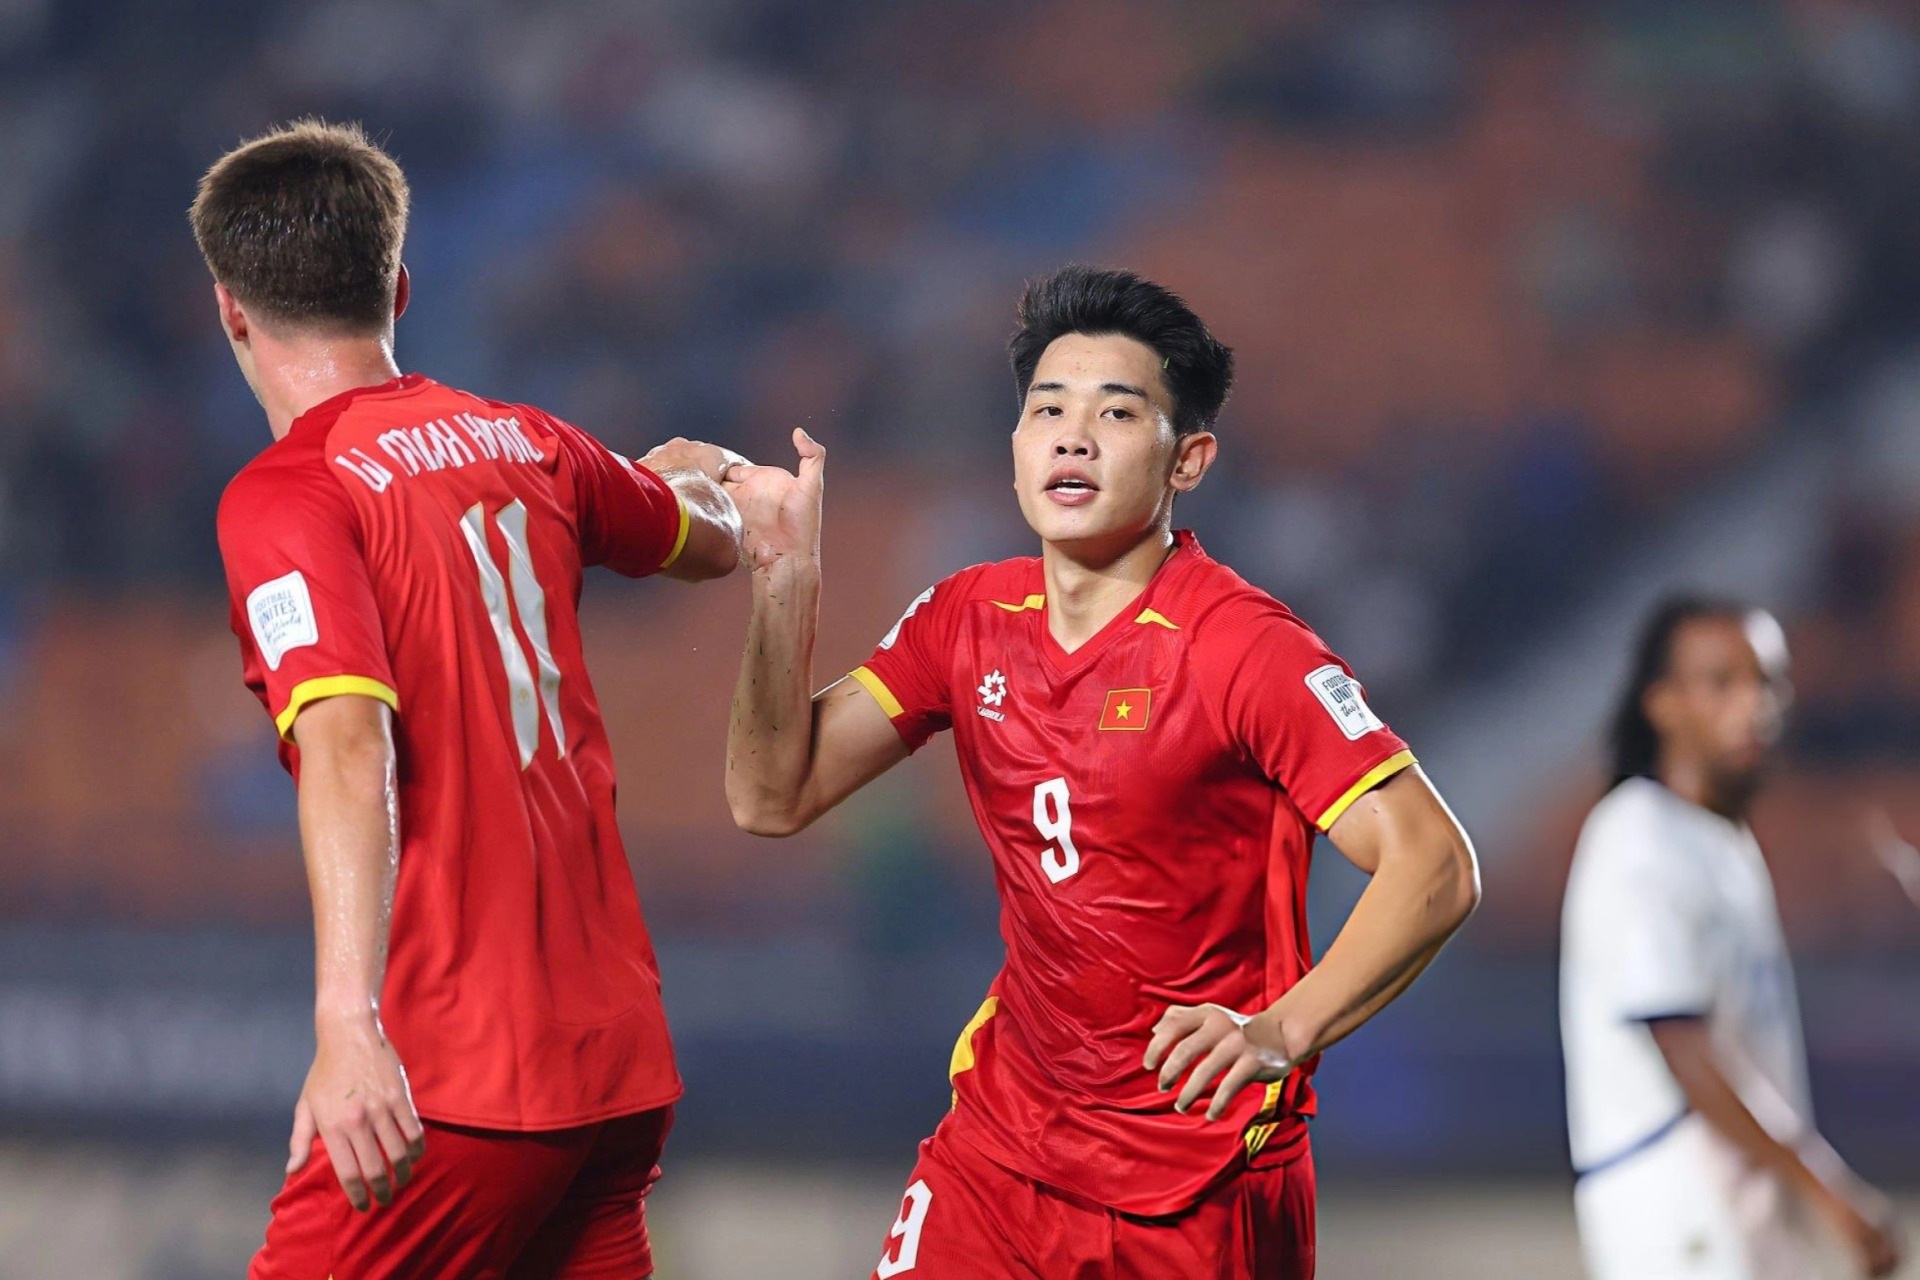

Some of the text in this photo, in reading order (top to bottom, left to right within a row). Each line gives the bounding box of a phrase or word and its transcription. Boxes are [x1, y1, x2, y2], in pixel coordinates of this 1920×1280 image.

[459, 497, 566, 772] 11
[1329, 683, 1354, 704] UNIT
[1033, 776, 1080, 885] 9
[876, 1178, 933, 1280] 9
